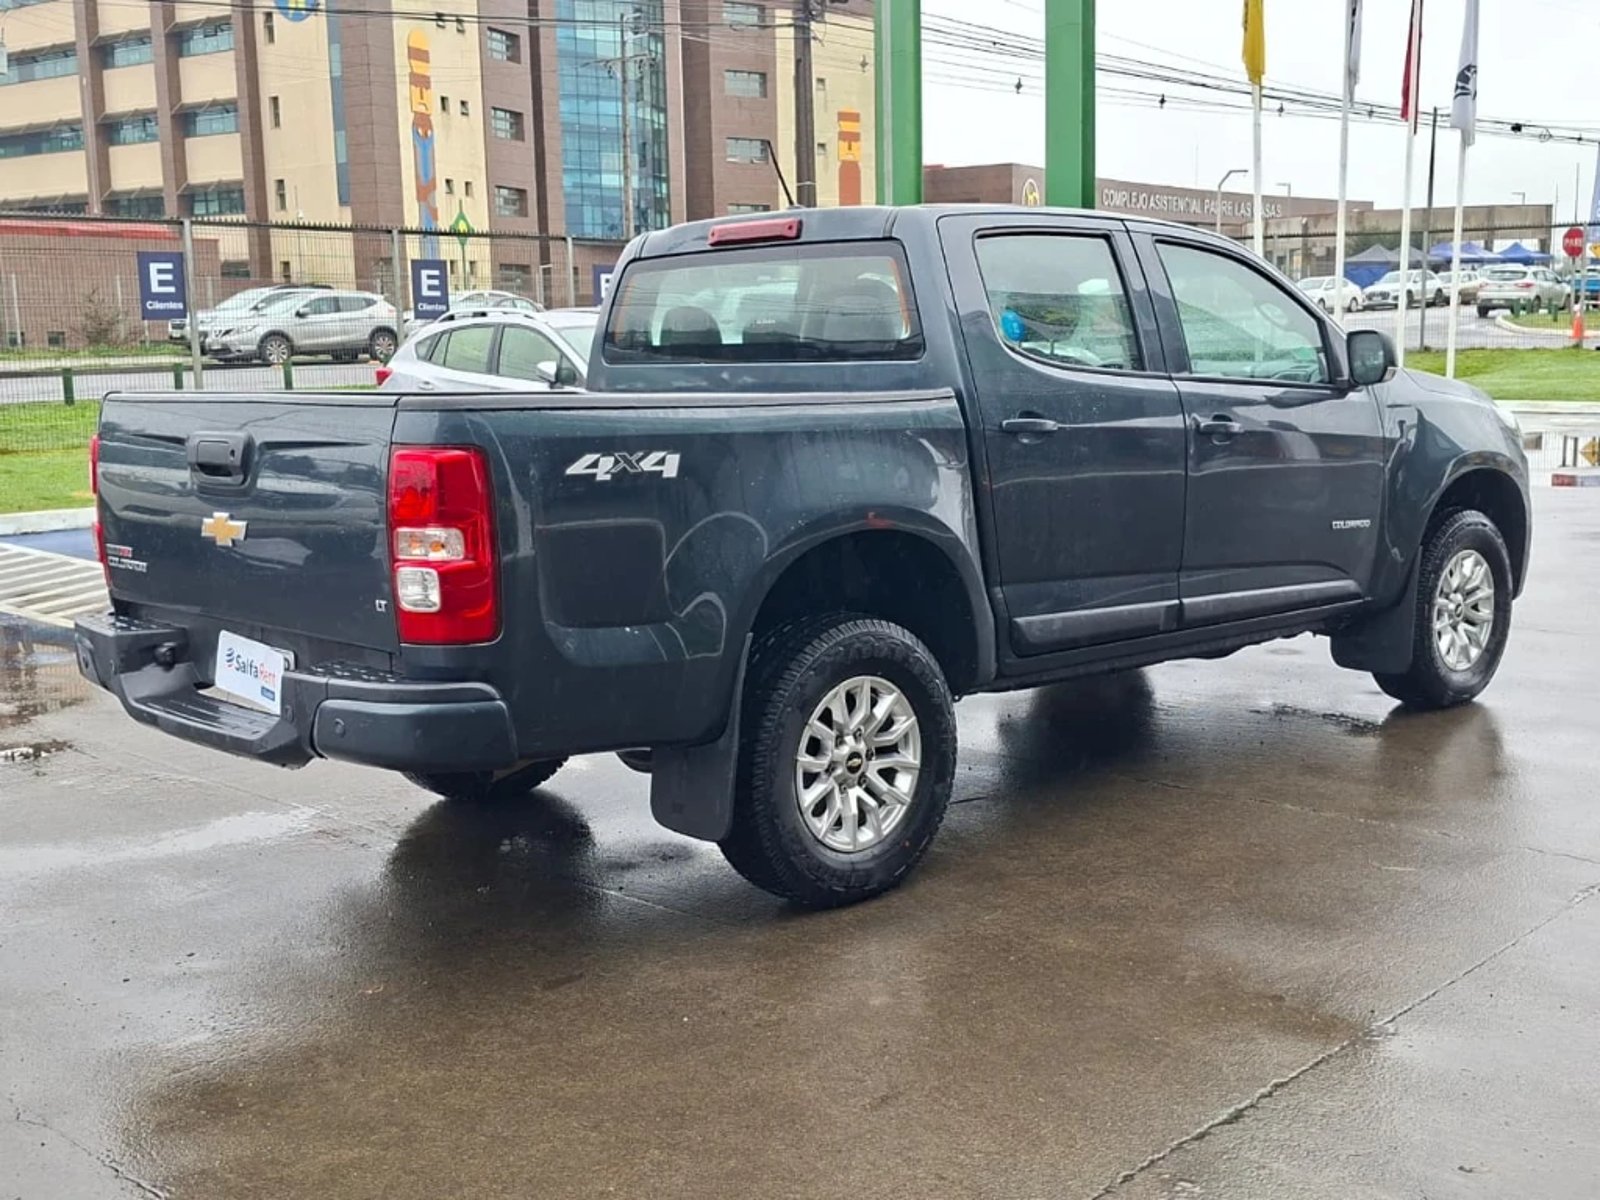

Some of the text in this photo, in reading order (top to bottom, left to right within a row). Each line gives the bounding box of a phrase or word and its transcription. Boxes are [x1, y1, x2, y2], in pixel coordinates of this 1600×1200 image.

[1102, 188, 1148, 210] COMPLEJO
[1204, 198, 1233, 216] PARE
[1235, 201, 1252, 217] LAS
[149, 262, 176, 293] E
[420, 269, 442, 297] E
[146, 300, 184, 310] Clientes
[418, 302, 447, 311] Clientes
[375, 599, 388, 612] LT
